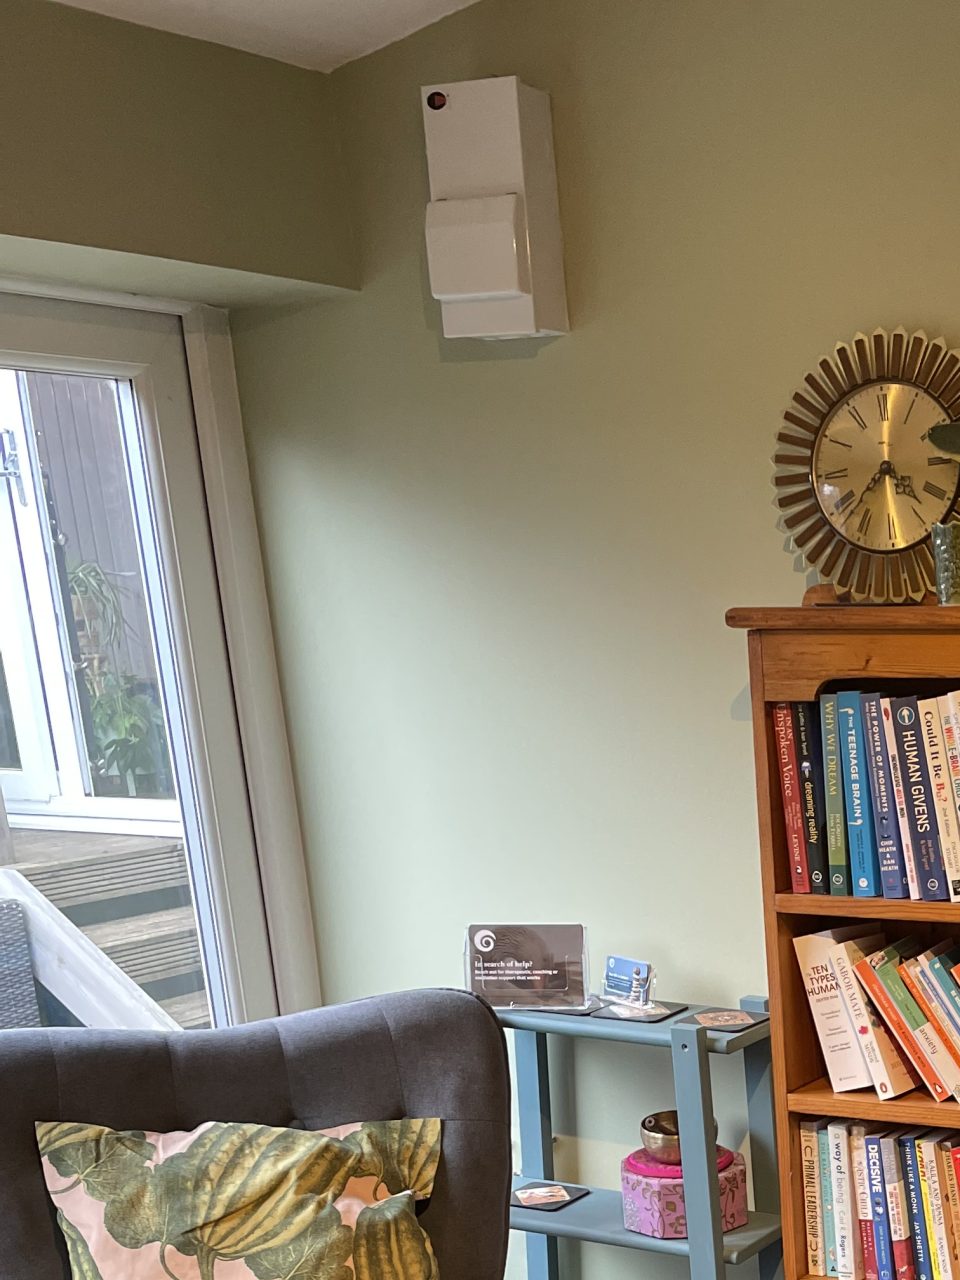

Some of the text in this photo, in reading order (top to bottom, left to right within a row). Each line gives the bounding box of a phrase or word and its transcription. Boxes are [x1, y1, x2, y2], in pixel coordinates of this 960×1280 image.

[772, 702, 793, 763] Unspoken
[922, 710, 938, 748] Could
[943, 715, 951, 725] THE
[823, 701, 838, 795] WHY WE DREAM
[847, 729, 858, 780] TEENAGE
[869, 701, 888, 812] THE POWER OF MOMENTS
[930, 750, 940, 760] It
[781, 763, 795, 797] Voice
[901, 729, 931, 833] HUMAN GIVENS
[932, 763, 943, 779] Be
[802, 781, 818, 844] dreaming reality
[851, 783, 861, 817] BRAIN
[791, 833, 800, 862] LEVINE
[514, 960, 532, 968] help?
[809, 972, 835, 985] TYPES
[810, 963, 828, 975] TEN
[833, 955, 855, 992] GABOR
[917, 1026, 939, 1055] anxiety
[867, 1143, 881, 1193] DECISIVE
[903, 1142, 912, 1165] THINK
[906, 1166, 914, 1184] LIKE
[803, 1159, 819, 1238] PRIMAL LEADERSHIP
[832, 1142, 847, 1257] way of being Rogers
[909, 1191, 918, 1214] MONK
[914, 1235, 924, 1262] SHETTY
